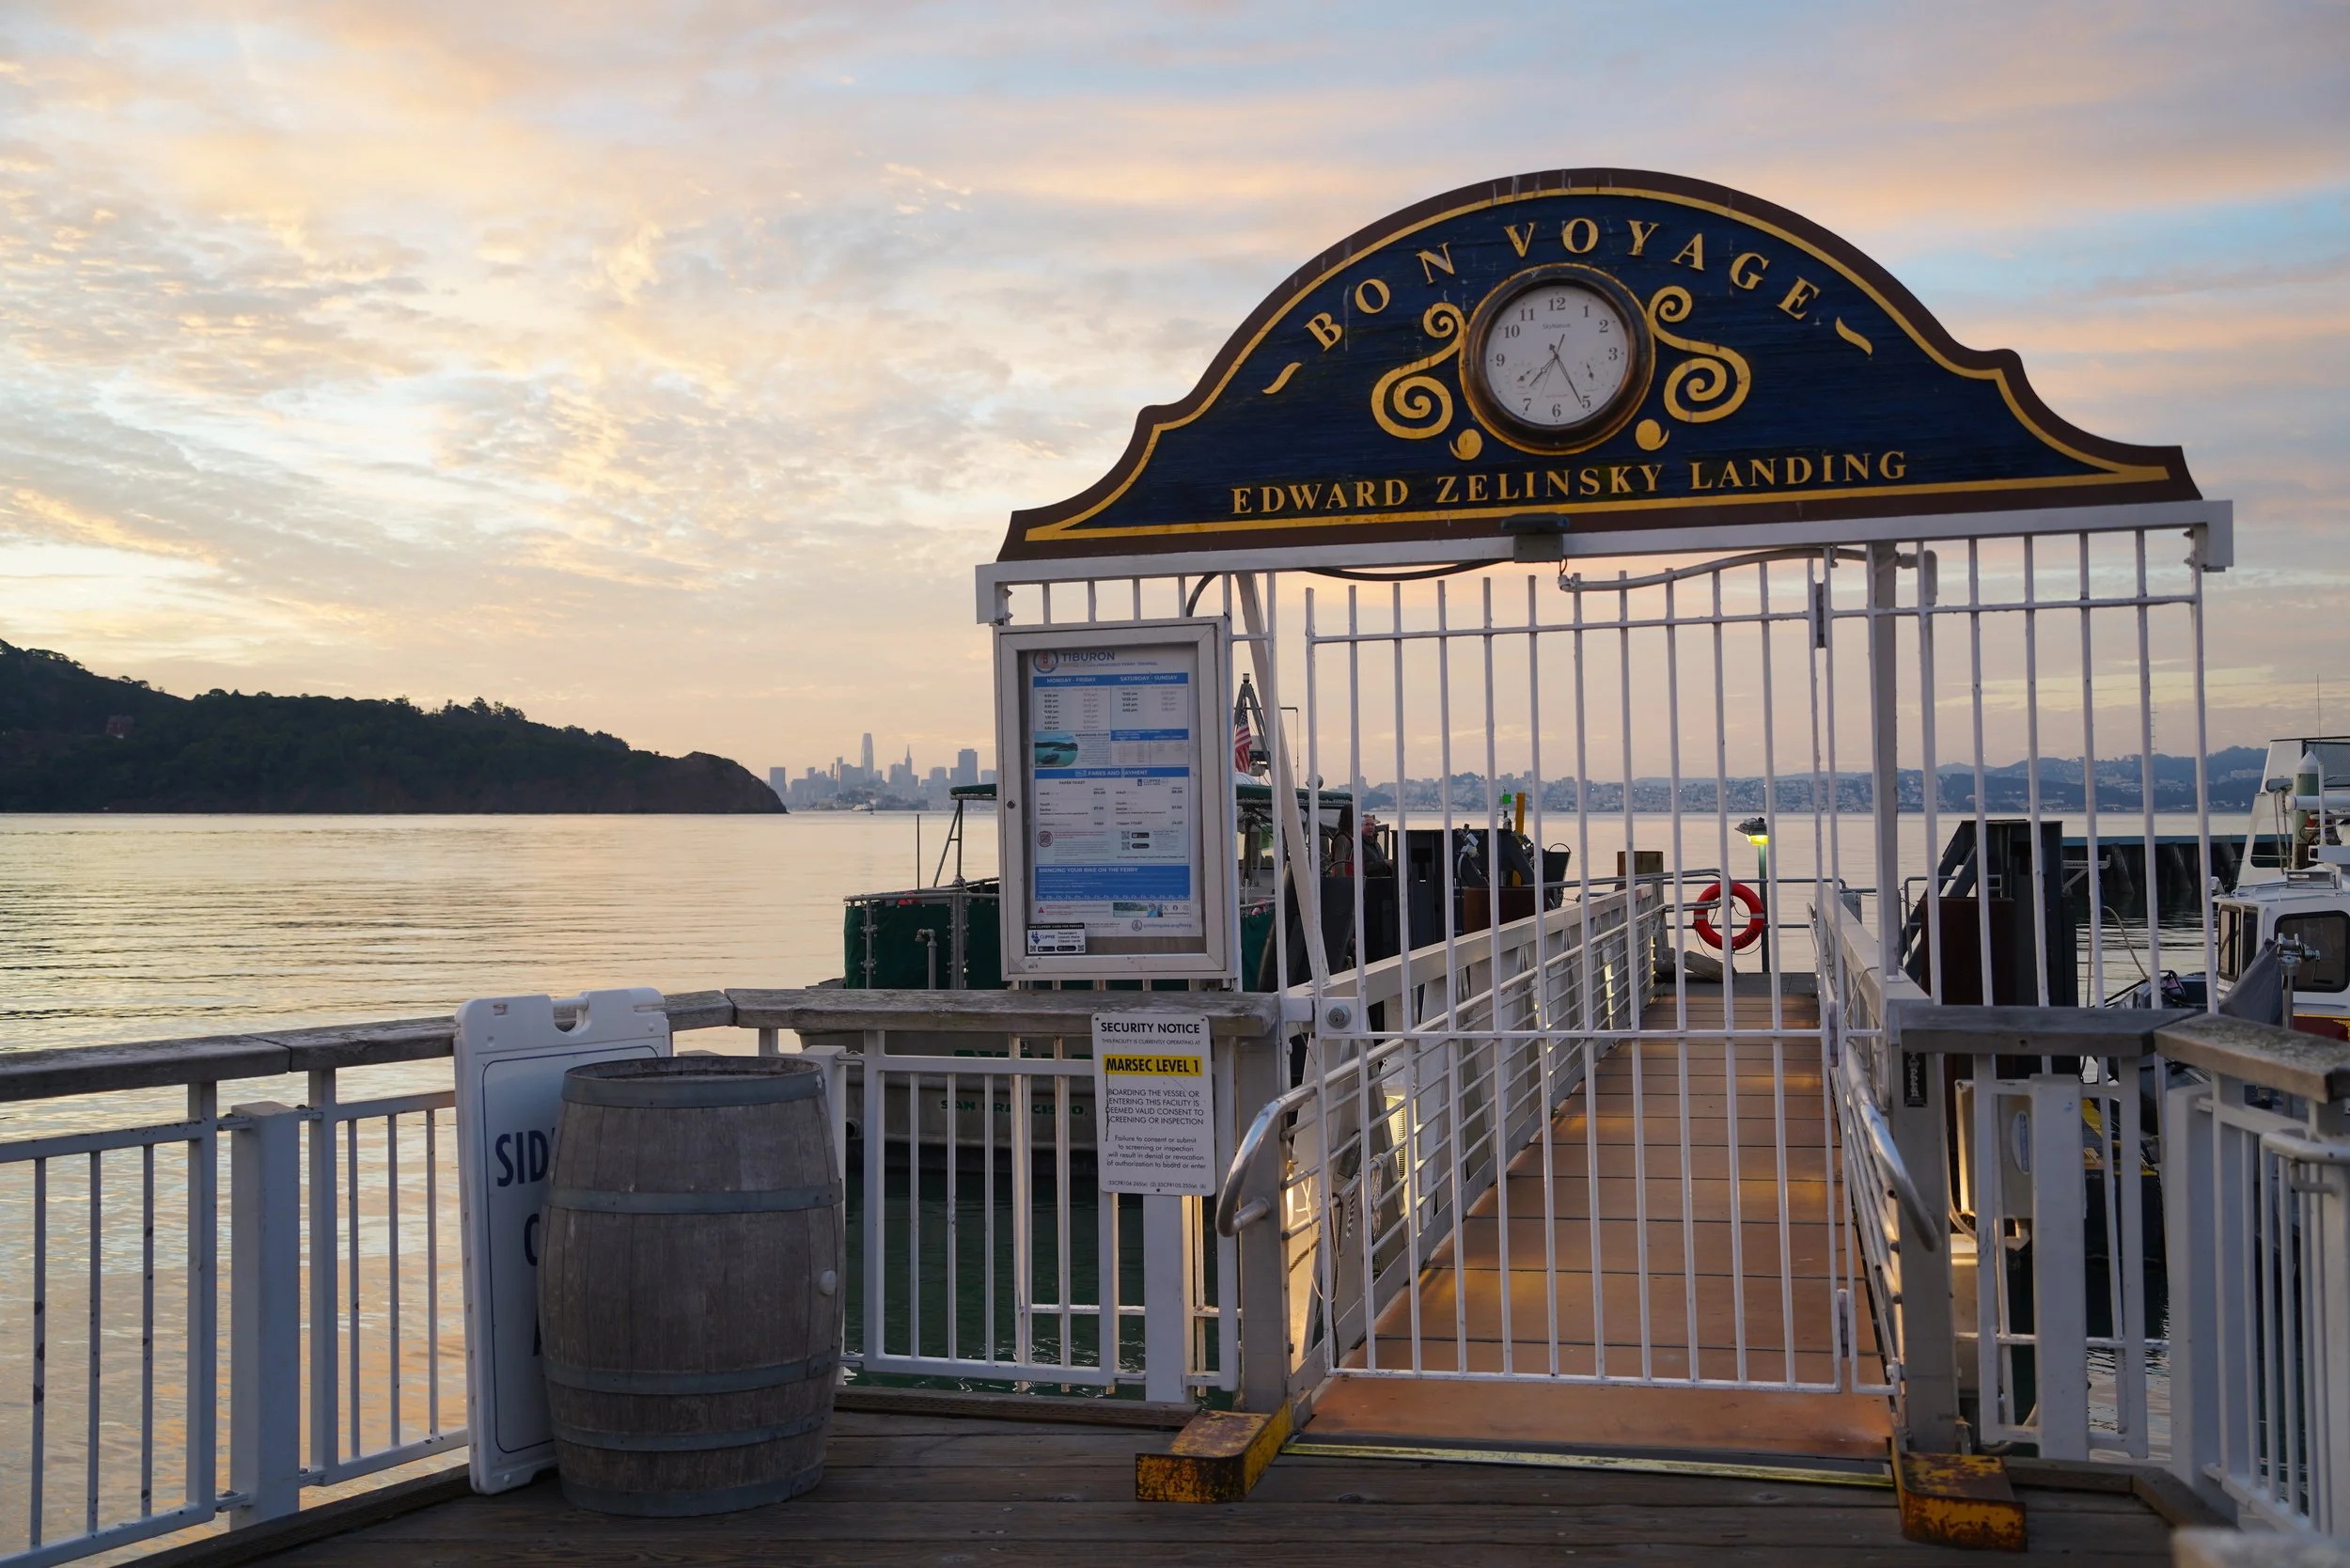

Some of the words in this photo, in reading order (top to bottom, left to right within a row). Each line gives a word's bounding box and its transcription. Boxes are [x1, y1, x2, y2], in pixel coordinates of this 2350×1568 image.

[1304, 241, 1456, 353] BON
[1504, 217, 1821, 321] VOYAGE
[1548, 297, 1566, 311] 12
[1520, 308, 1535, 321] 11
[1583, 305, 1590, 318] 1
[1504, 324, 1520, 338] 10
[1599, 320, 1609, 334] 2
[1496, 353, 1505, 368] 9
[1608, 347, 1618, 361] 3
[1523, 399, 1532, 412] 7
[1582, 396, 1591, 409] 5
[1552, 404, 1561, 417] 6
[1231, 478, 1408, 515] EDWARD
[1436, 463, 1663, 504] ZELINSKY
[1690, 450, 1907, 490] LANDING
[1061, 651, 1116, 662] TIBURON
[1101, 1022, 1154, 1033] SECURITY
[1157, 1023, 1200, 1034] NOTICE
[1106, 1058, 1152, 1072] MARSEC
[1156, 1058, 1190, 1073] LEVEL
[1193, 1059, 1198, 1073] 1
[1108, 1089, 1147, 1097] BOARDING
[940, 1099, 977, 1111] SAN
[982, 1102, 1089, 1116] RACISO,
[1105, 1106, 1134, 1115] DEEMED
[1160, 1117, 1204, 1125] INSPECTION
[495, 1127, 556, 1188] SID
